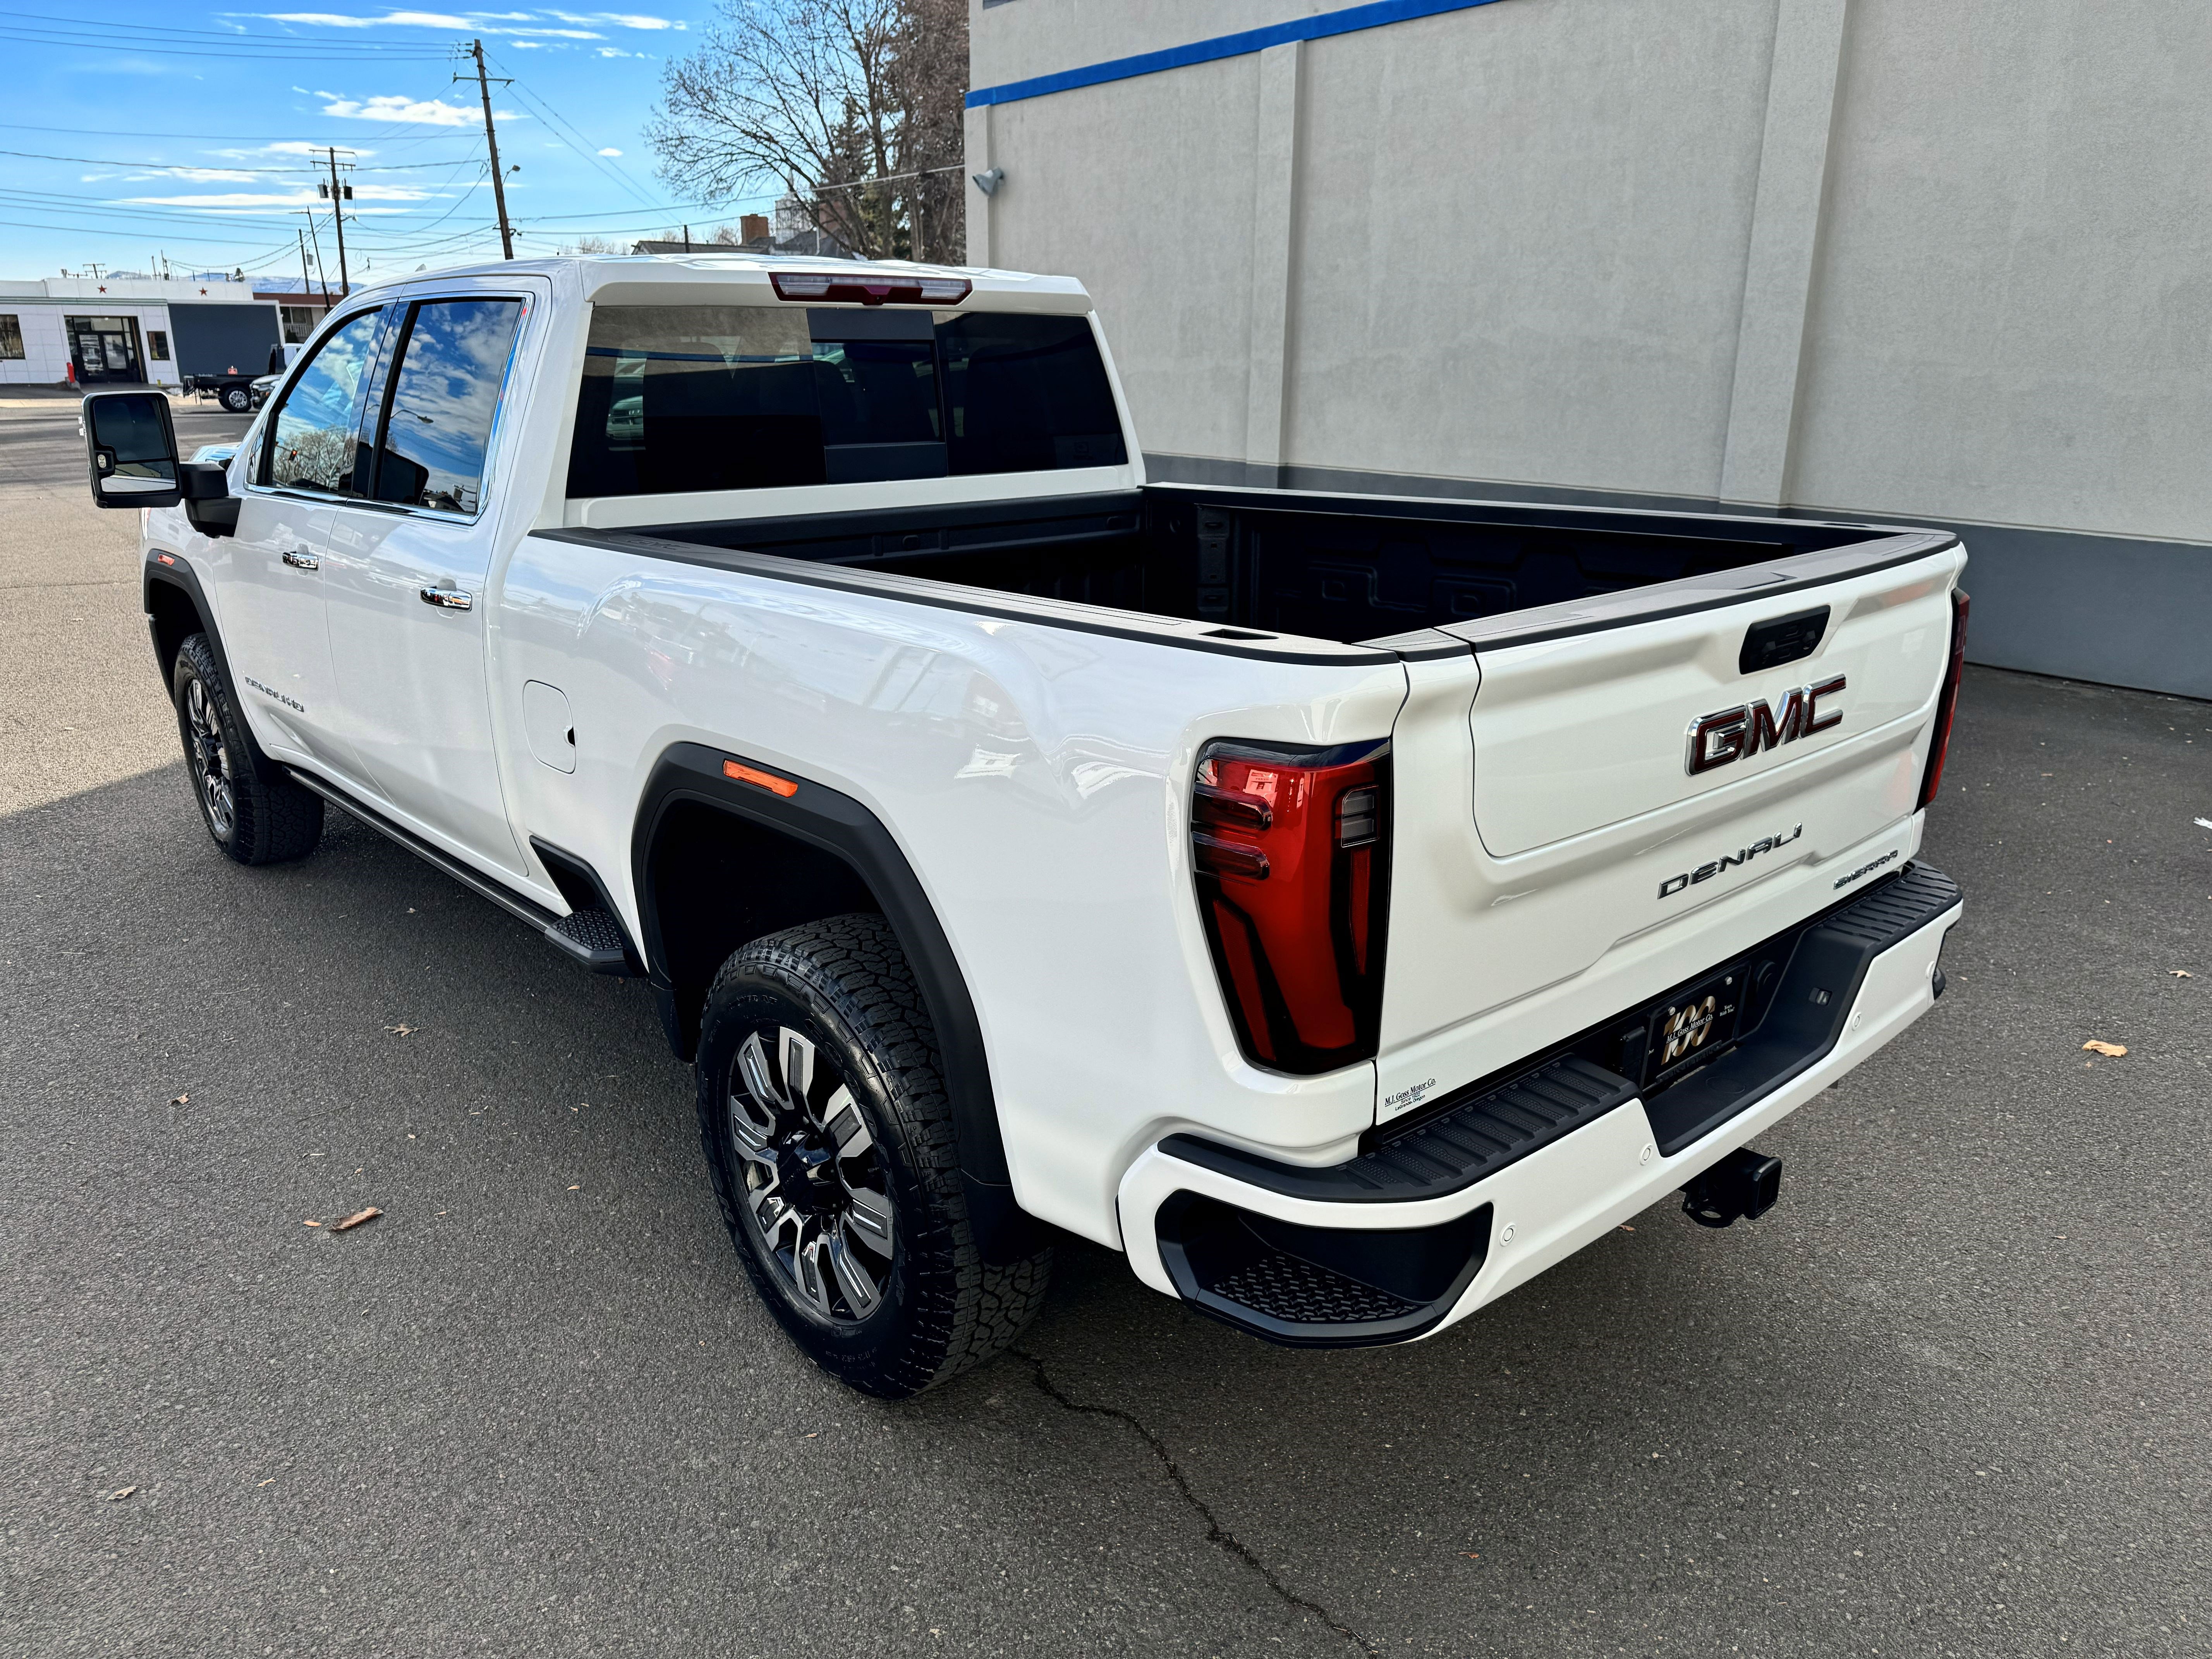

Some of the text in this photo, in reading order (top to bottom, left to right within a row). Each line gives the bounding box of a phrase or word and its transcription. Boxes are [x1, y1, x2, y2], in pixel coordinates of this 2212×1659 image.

[245, 677, 286, 704] DENALI
[1685, 673, 1846, 776] GMC
[1657, 822, 1802, 899] DENALI
[1833, 850, 1898, 890] SIERRA
[1661, 996, 1716, 1065] 100
[1678, 1026, 1689, 1036] Goss
[1690, 1018, 1705, 1029] Motor
[1385, 1095, 1395, 1105] M.J.
[1396, 1090, 1409, 1100] Goss
[1410, 1082, 1426, 1094] Motor
